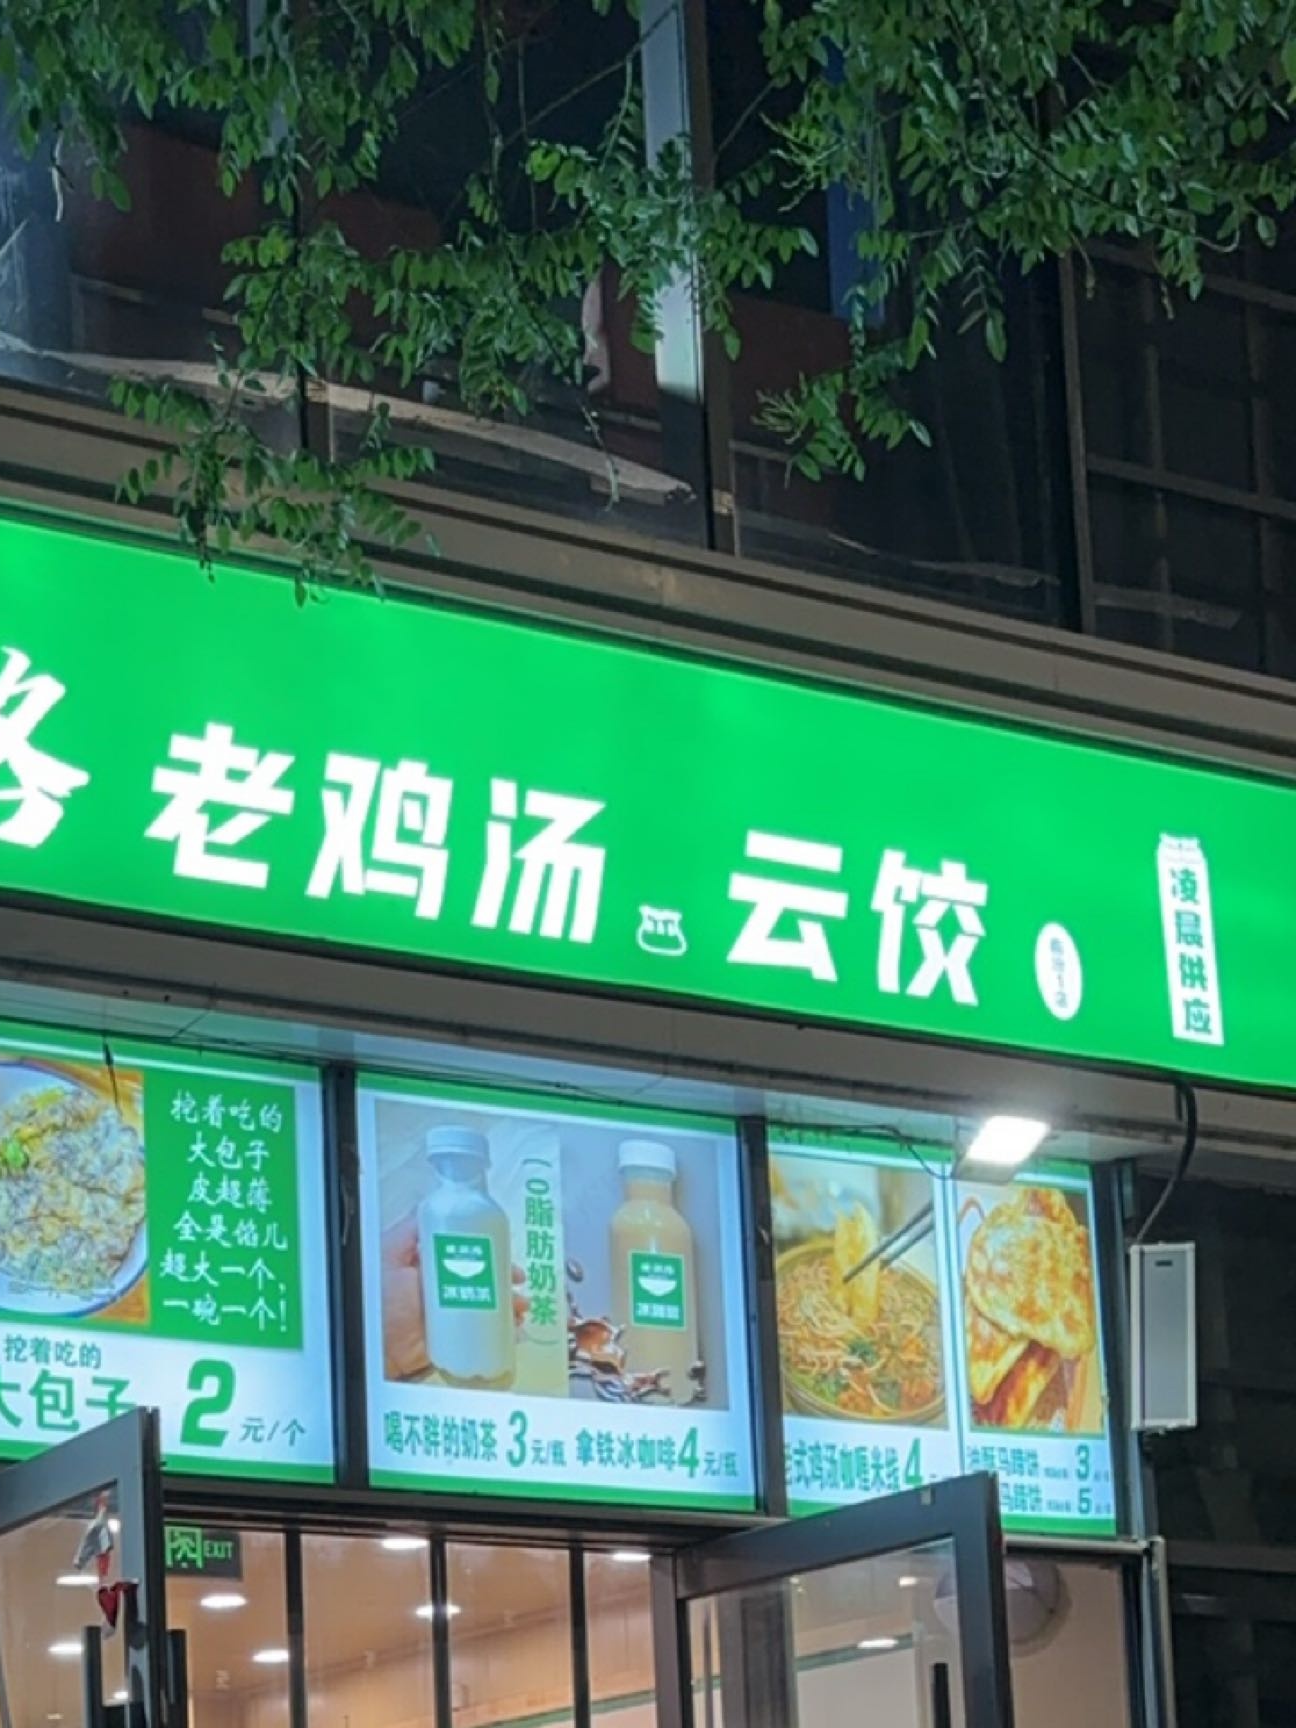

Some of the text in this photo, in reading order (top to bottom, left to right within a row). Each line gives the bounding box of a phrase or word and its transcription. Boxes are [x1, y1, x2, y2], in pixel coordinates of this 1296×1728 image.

[145, 721, 607, 945] 老鸡汤
[725, 828, 989, 1008] 云饺
[1169, 867, 1213, 1036] 凌晨供应
[170, 1089, 283, 1134] 挖着吃的
[187, 1130, 271, 1173] 大包子
[187, 1170, 273, 1215] 皮超薄
[173, 1209, 289, 1251] 全是馅儿
[4, 1334, 102, 1369] 挖着吃的
[179, 1357, 236, 1448] 2
[239, 1416, 307, 1447] 元/个
[506, 1409, 529, 1468] 3
[677, 1426, 701, 1478] 4
[905, 1437, 924, 1486] 4
[1075, 1444, 1091, 1481] 3
[1077, 1487, 1092, 1514] 5
[205, 1540, 234, 1560] EXIT
